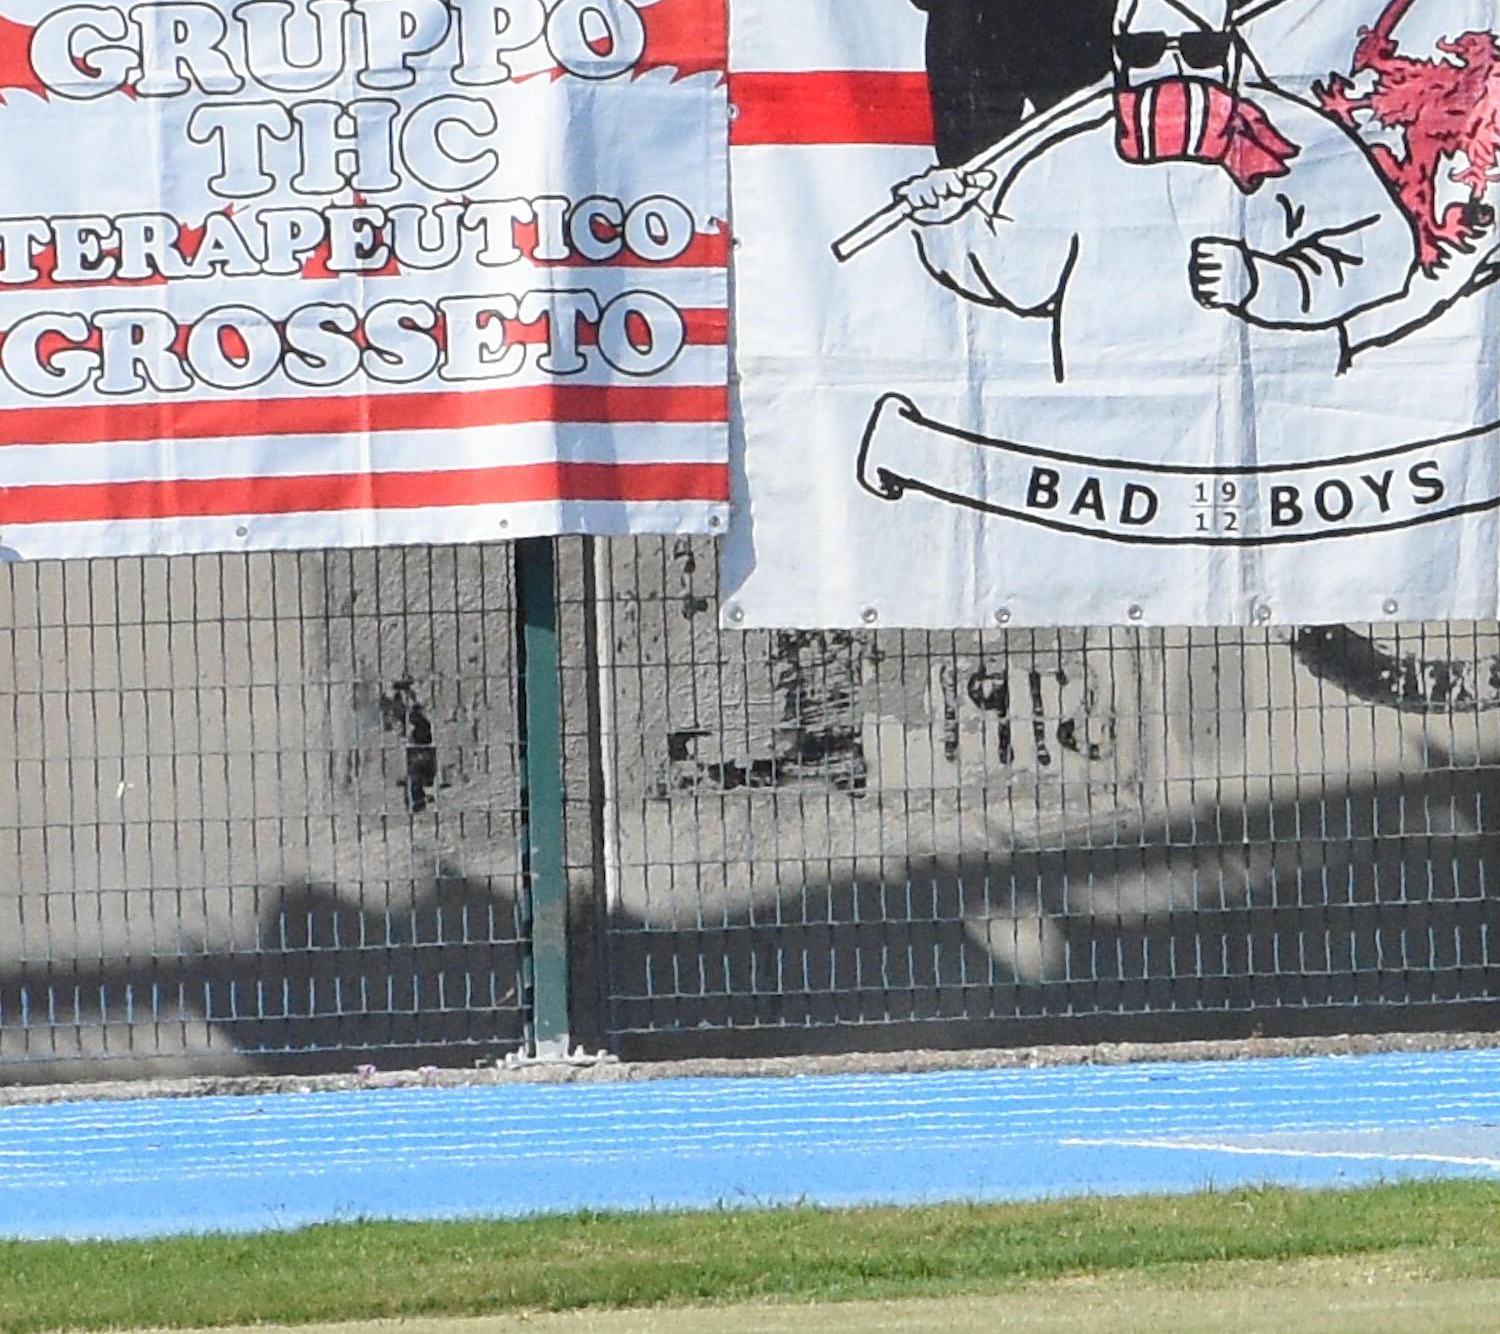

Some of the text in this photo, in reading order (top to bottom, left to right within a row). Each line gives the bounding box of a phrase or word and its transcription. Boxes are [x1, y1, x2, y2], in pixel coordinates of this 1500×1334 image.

[187, 93, 499, 199] THC
[0, 194, 696, 285] TERAPEUTICO
[1, 288, 686, 398] GROSSETO
[1025, 465, 1160, 528] BAD
[1268, 458, 1447, 529] BOYS
